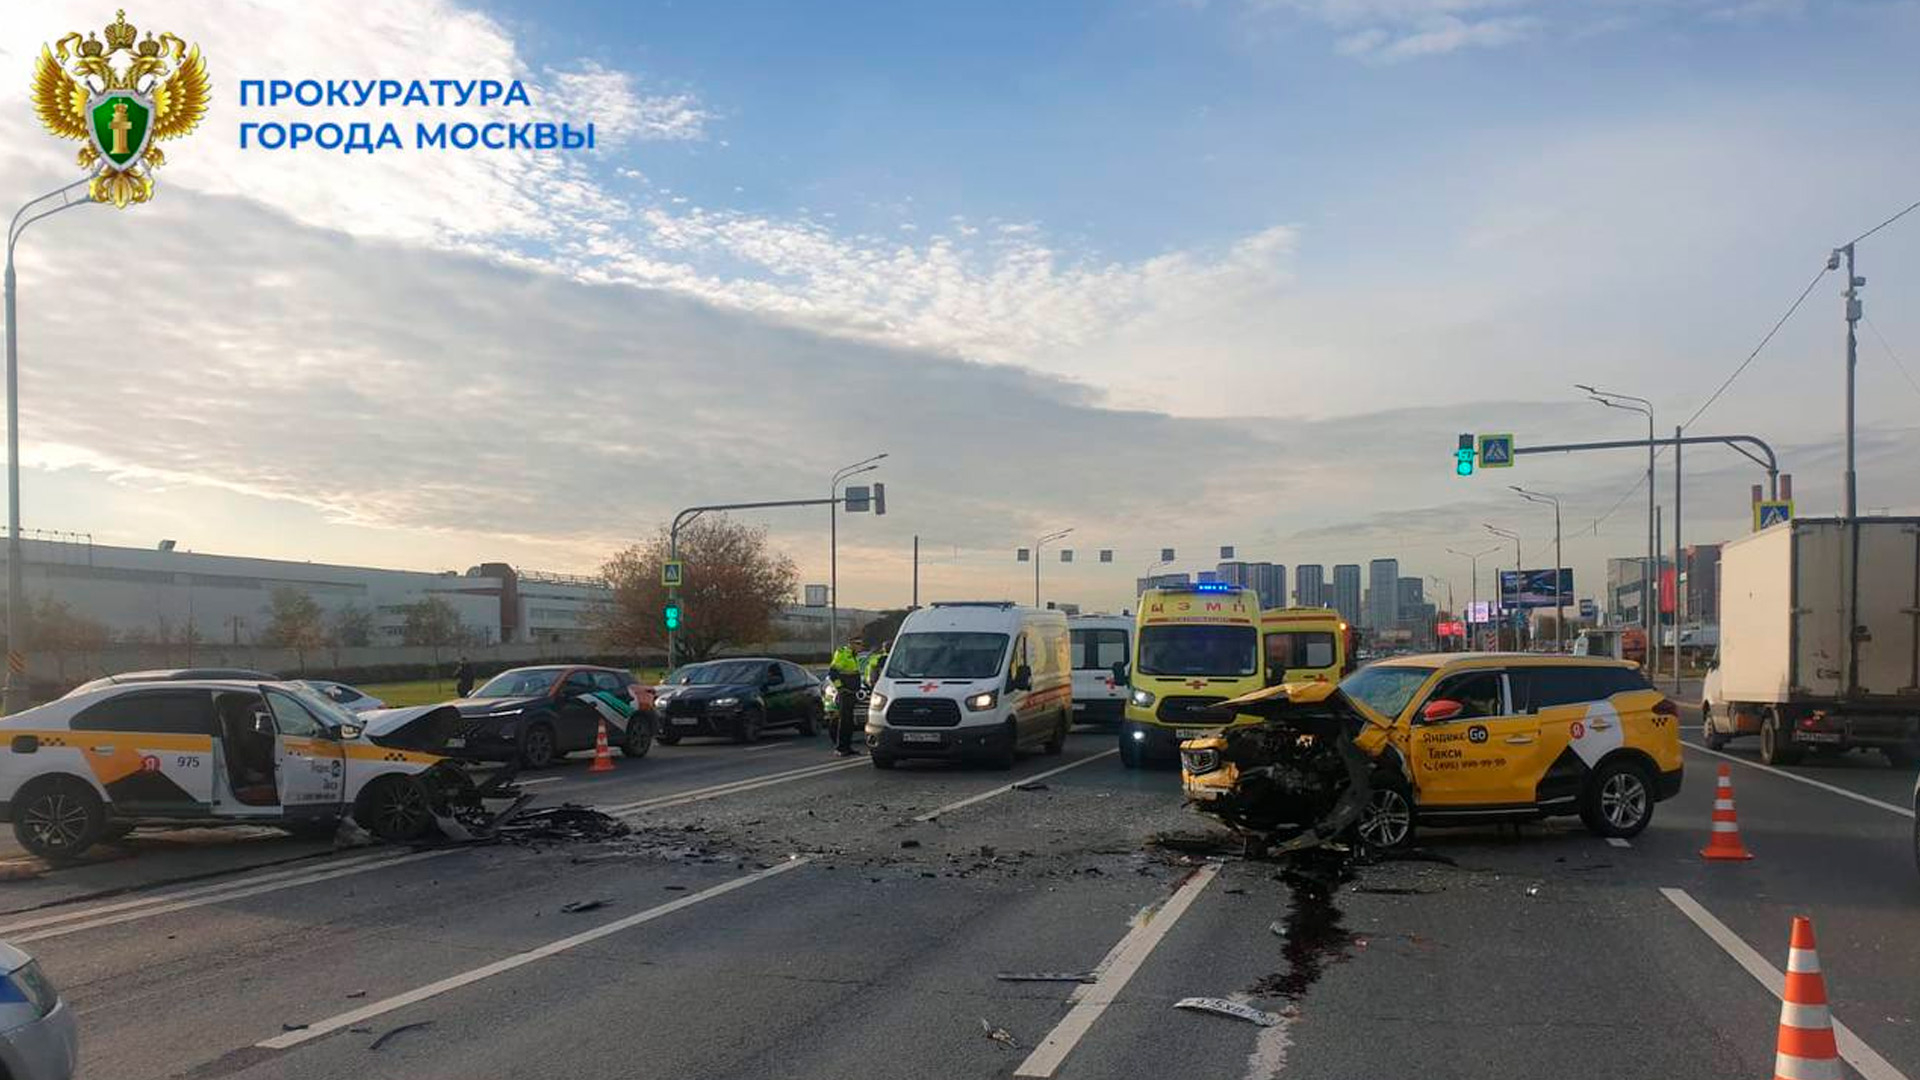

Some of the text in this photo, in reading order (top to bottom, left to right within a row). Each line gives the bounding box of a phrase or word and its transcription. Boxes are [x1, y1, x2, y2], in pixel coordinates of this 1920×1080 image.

[1422, 727, 1486, 743] Яндекс Go
[1427, 748, 1462, 759] Такси
[177, 756, 200, 768] 975
